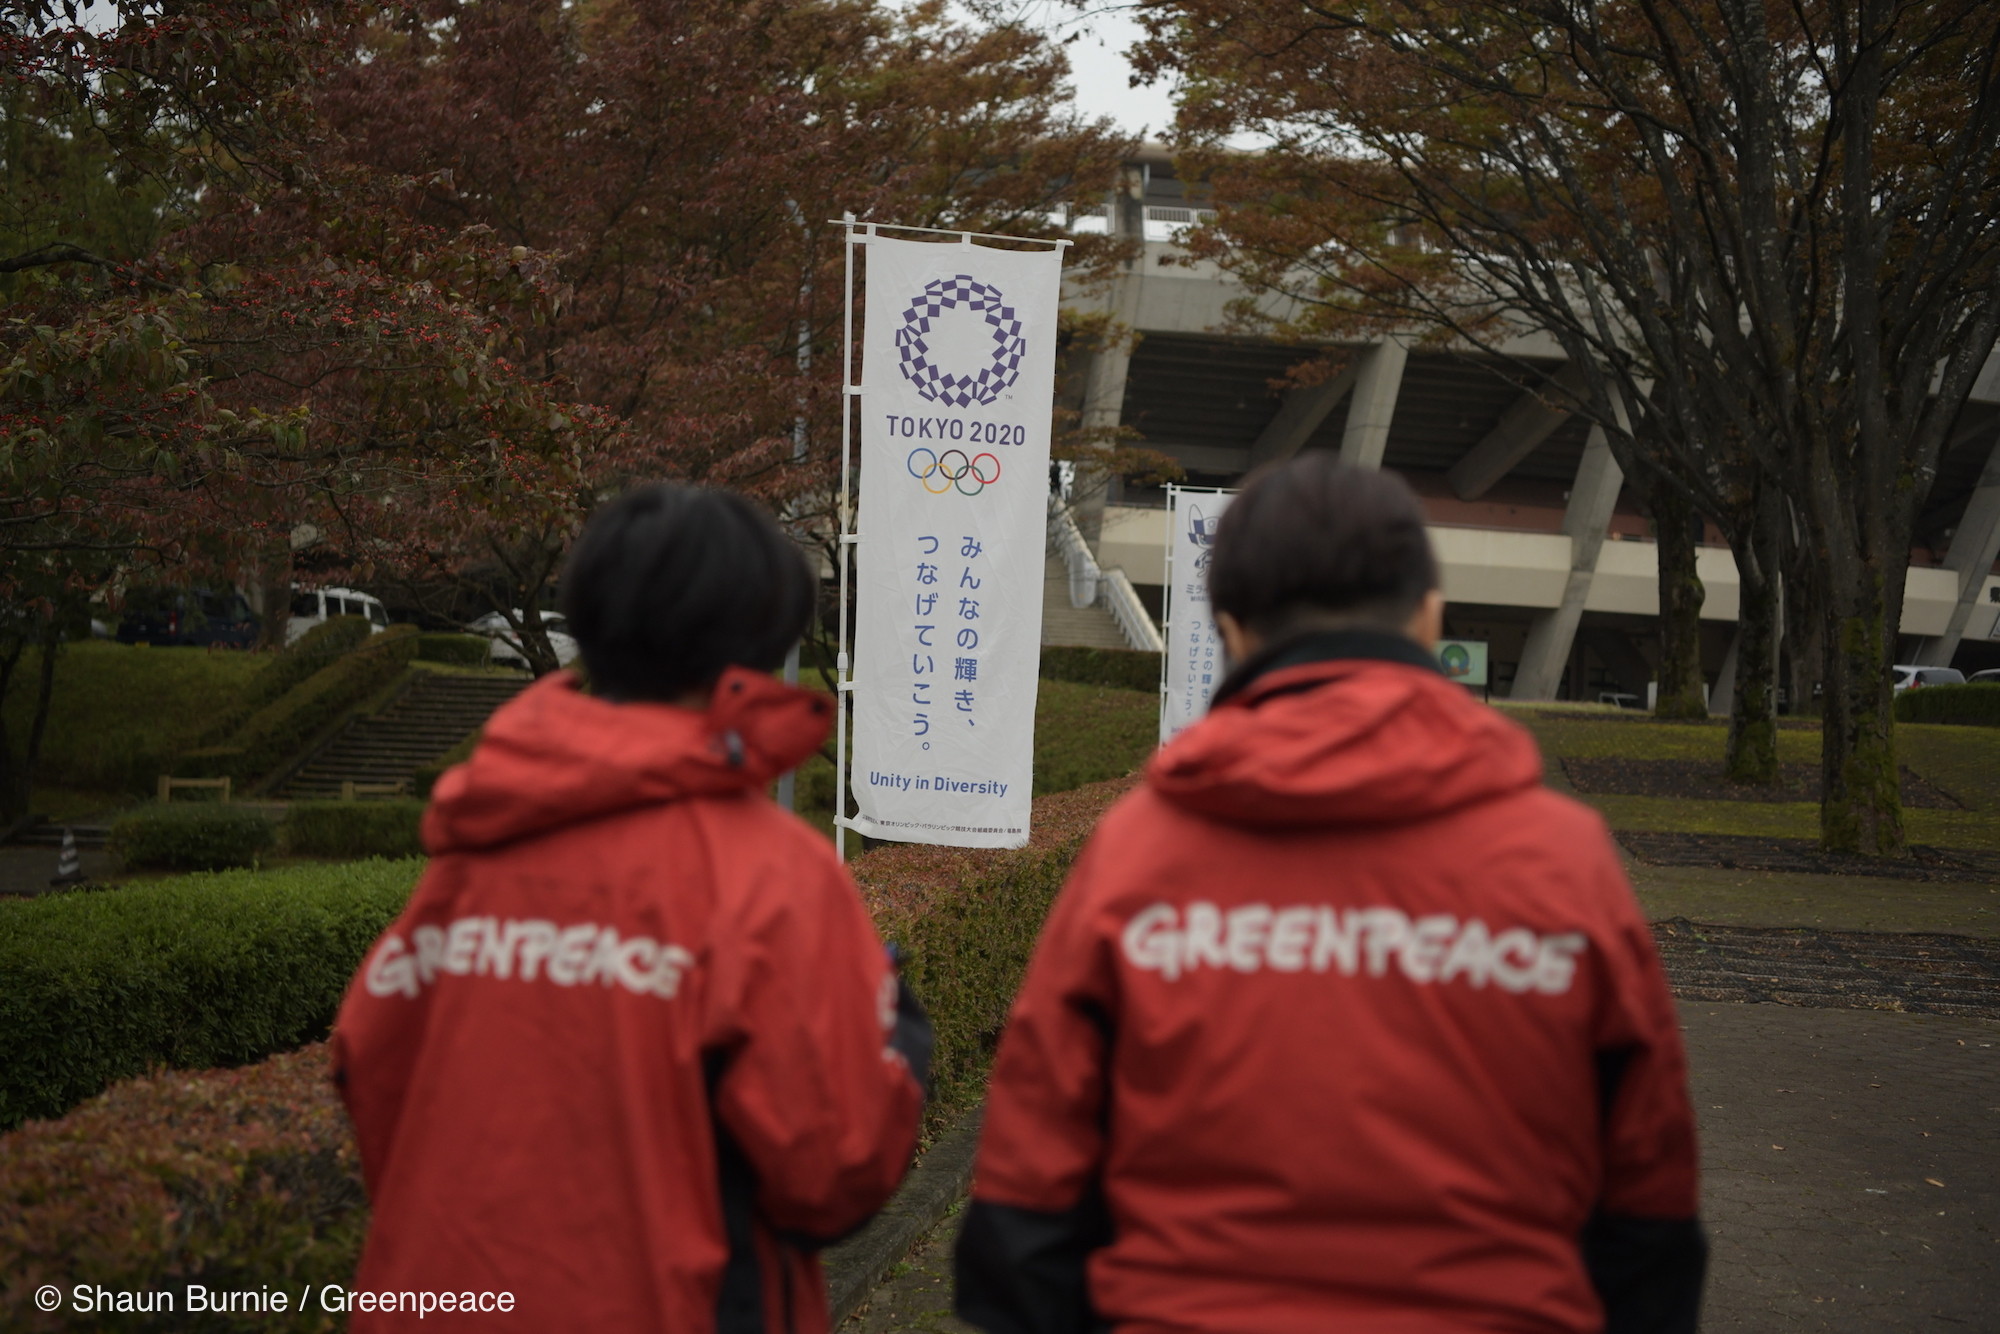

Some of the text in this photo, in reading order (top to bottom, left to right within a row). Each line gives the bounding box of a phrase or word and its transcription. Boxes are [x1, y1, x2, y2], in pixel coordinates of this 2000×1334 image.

[886, 415, 1025, 446] TOKYO 2020
[912, 535, 939, 751] つなげていこう。
[954, 536, 982, 727] みんなの輝き、
[870, 771, 1008, 798] Unity in Diversity
[1123, 900, 1587, 996] GREENPEACE
